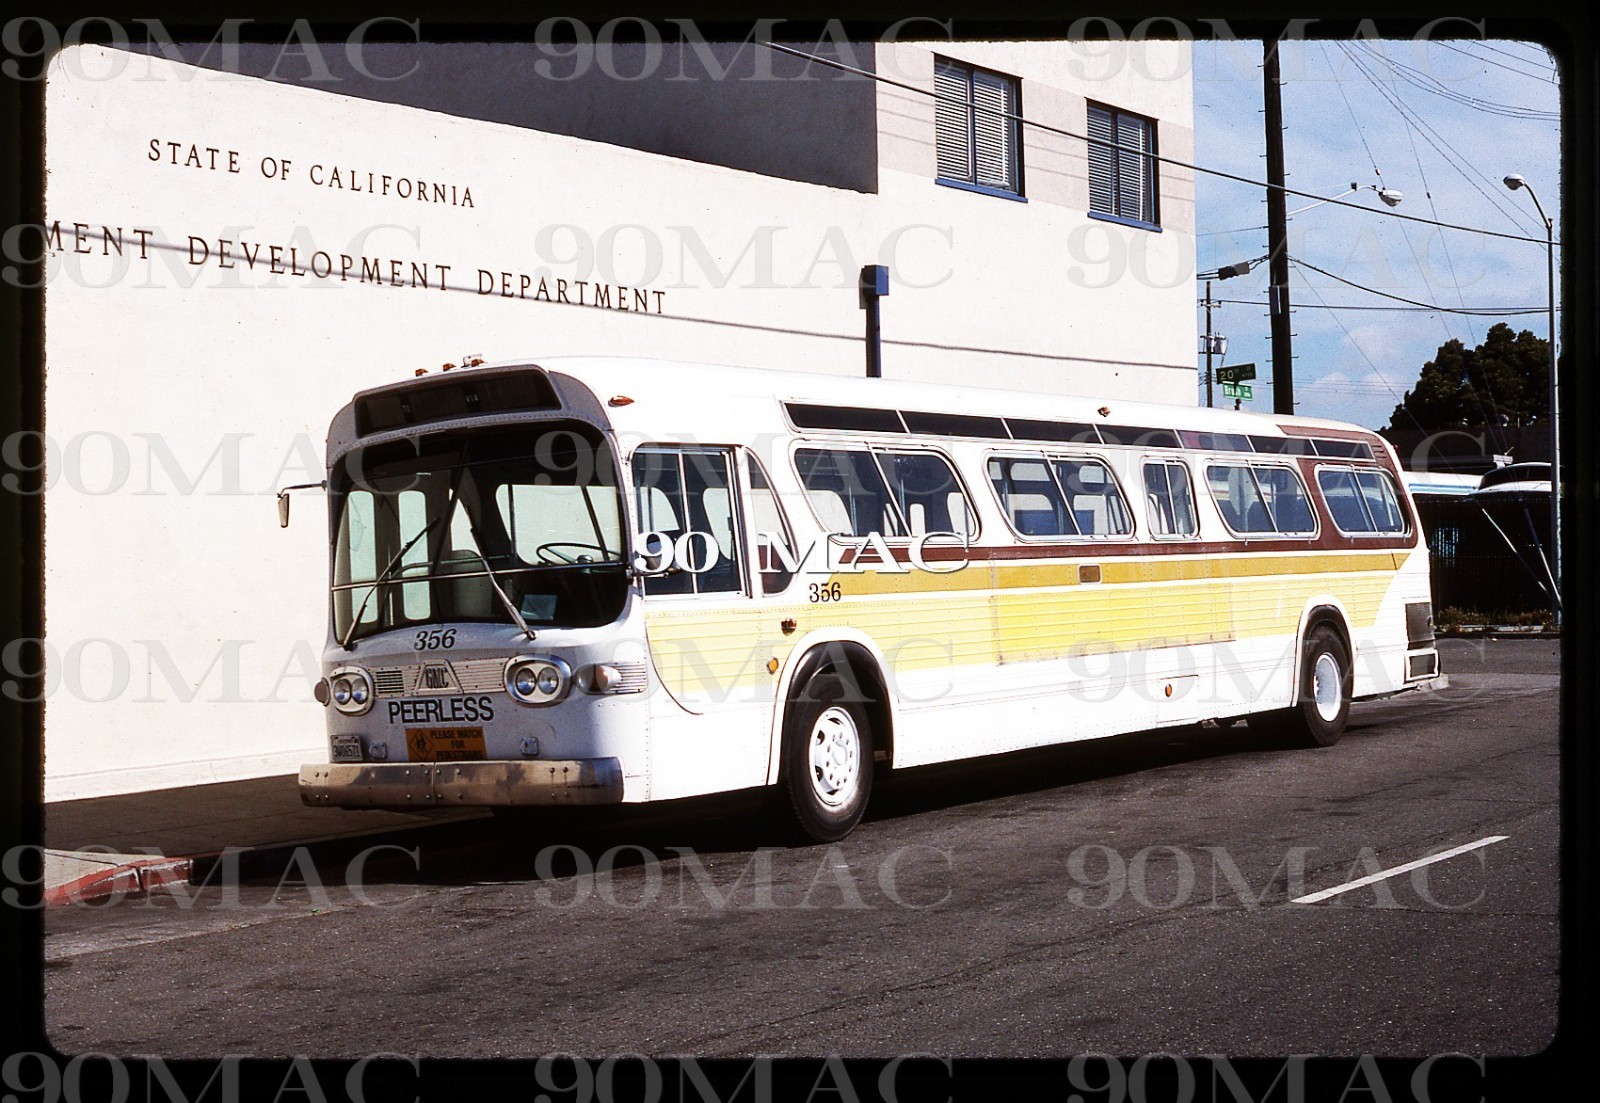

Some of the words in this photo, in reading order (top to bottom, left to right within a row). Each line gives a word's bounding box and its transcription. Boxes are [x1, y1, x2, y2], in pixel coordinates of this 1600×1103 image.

[148, 138, 241, 174] STATE
[261, 156, 292, 181] OF
[310, 164, 475, 209] CALIFORNIA
[188, 235, 451, 292] DEVELOPMENT
[478, 268, 666, 315] DEPARTMENT
[809, 582, 842, 603] 356
[414, 628, 456, 650] 356
[425, 666, 449, 689] GMC
[388, 697, 495, 724] PEERLESS
[430, 730, 456, 739] PLEASE
